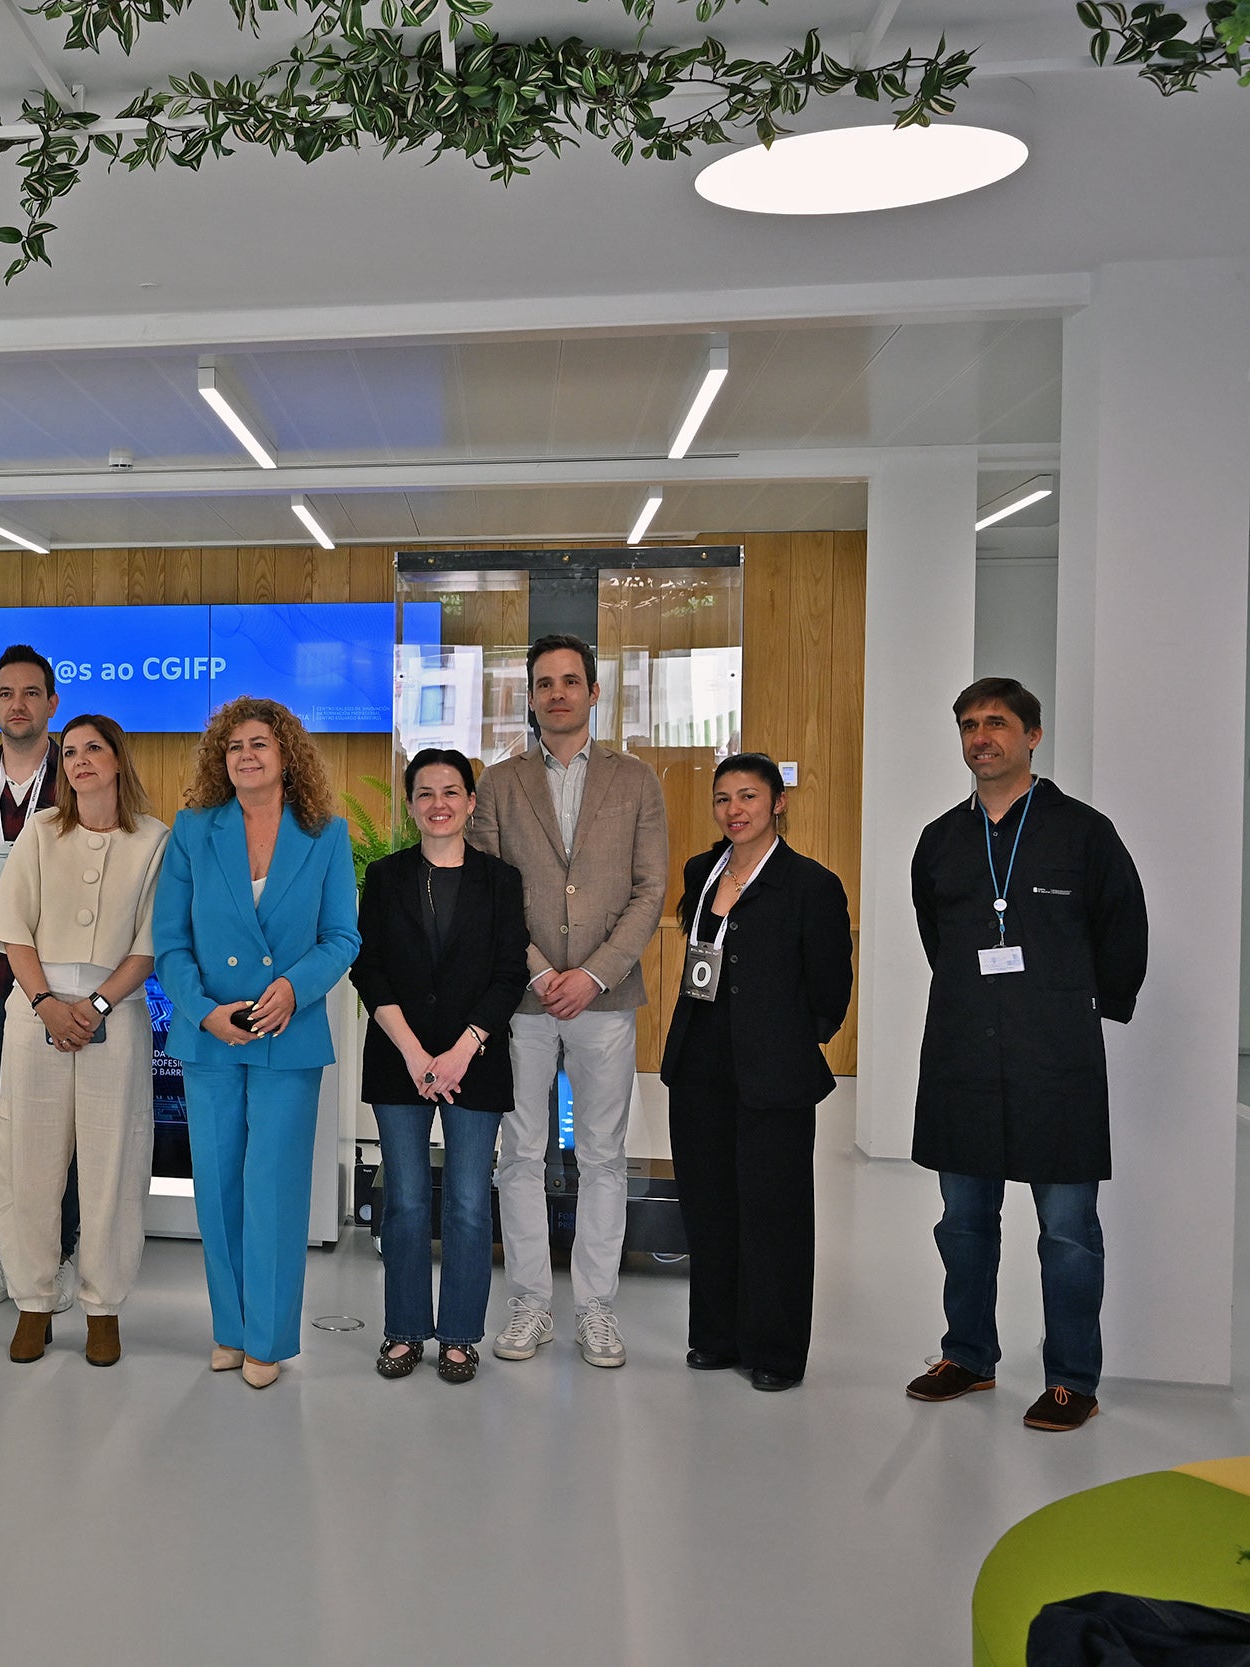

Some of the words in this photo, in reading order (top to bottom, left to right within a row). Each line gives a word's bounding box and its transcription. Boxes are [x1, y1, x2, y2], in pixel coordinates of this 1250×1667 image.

[101, 662, 134, 681] ao
[142, 657, 227, 681] CGIFP
[154, 1050, 166, 1058] DA
[152, 1059, 183, 1067] ROFESI
